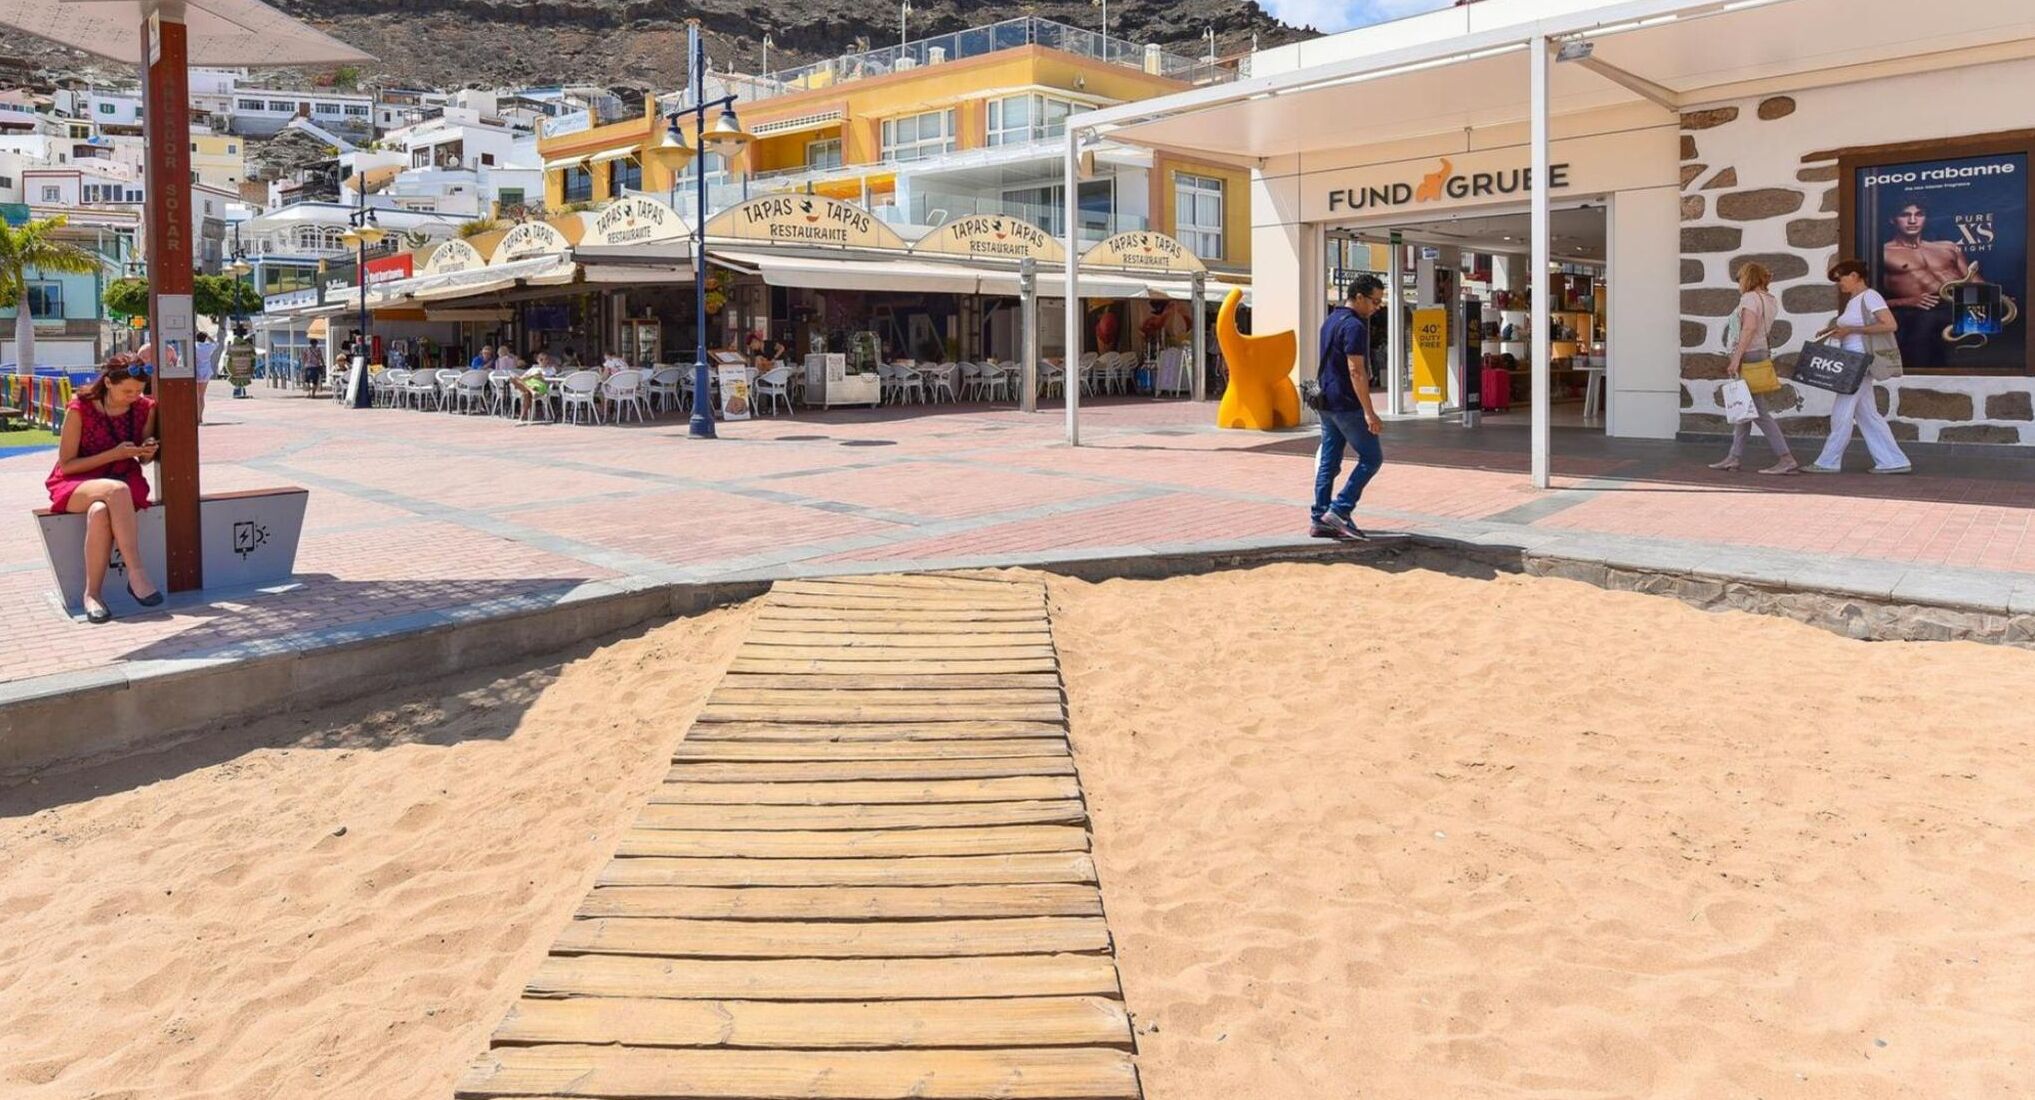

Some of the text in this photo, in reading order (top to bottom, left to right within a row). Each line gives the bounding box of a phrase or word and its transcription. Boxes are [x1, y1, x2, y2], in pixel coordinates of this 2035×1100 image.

[1864, 162, 2015, 187] paco rabanne
[1329, 183, 1412, 211] FUND
[165, 184, 180, 251] SOLAR
[596, 198, 664, 236] TAPAS TAPAS
[743, 198, 870, 233] TAPAS TAPAS
[1955, 213, 1994, 223] PURE
[608, 225, 651, 245] RESTAURANTE
[769, 223, 848, 242] RESTAURANTE
[951, 218, 1044, 248] TAPAS TAPAS
[1957, 222, 1995, 245] XS
[970, 240, 1029, 256] RESTAURANTE
[1108, 234, 1181, 259] TAPAS TAPAS
[1955, 244, 1993, 252] NIGHT
[1123, 253, 1169, 267] RESTAURANTE
[1810, 356, 1844, 374] RKS
